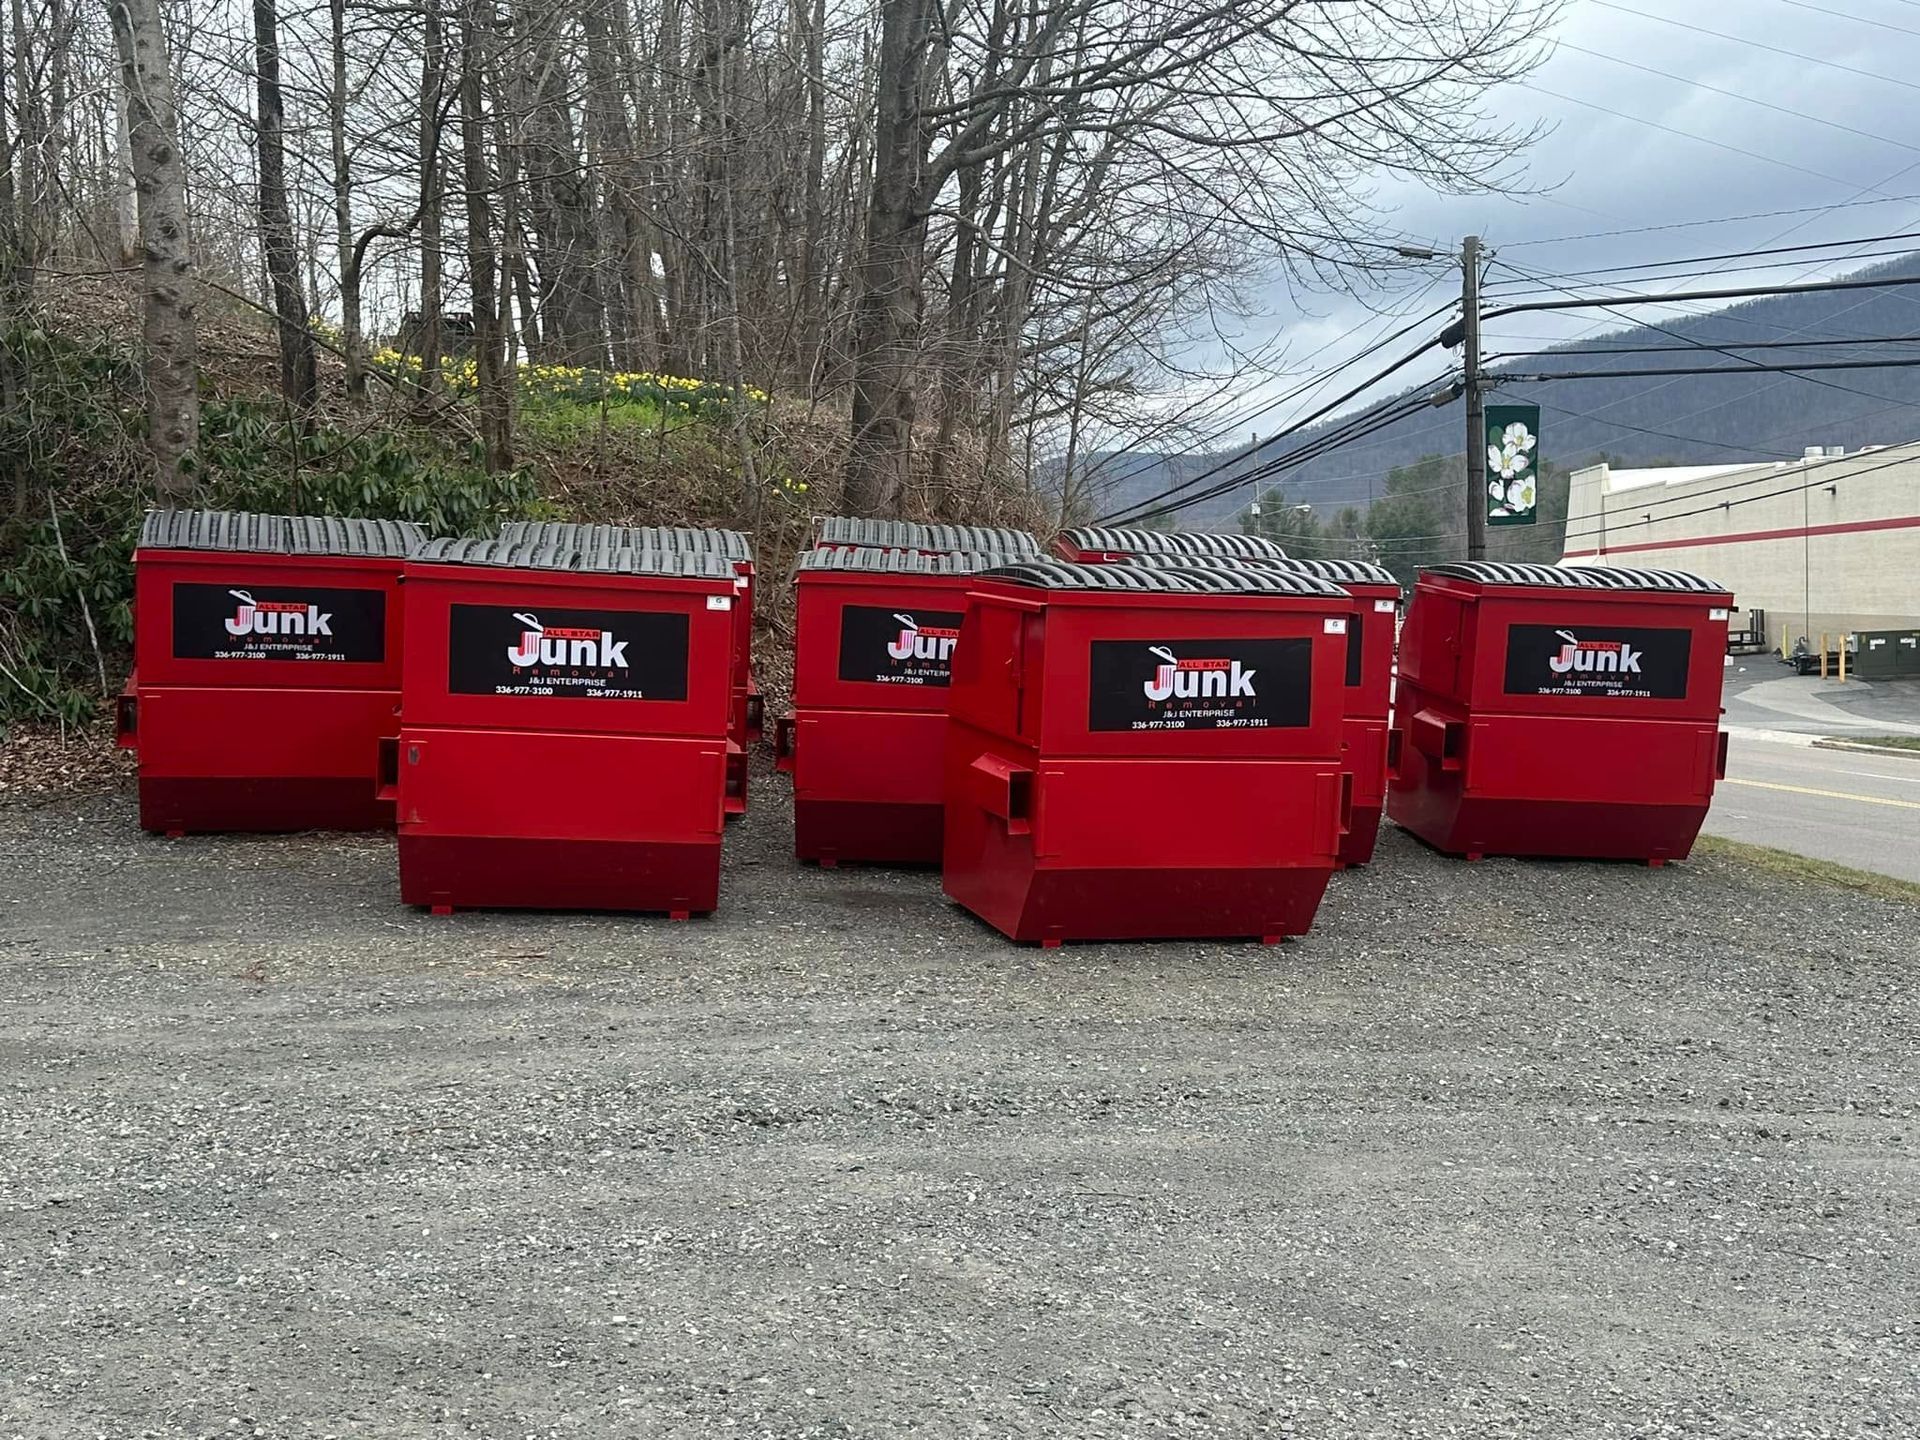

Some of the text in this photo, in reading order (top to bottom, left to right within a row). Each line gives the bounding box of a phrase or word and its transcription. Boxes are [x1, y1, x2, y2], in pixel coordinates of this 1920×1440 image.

[225, 604, 333, 636] Junk
[545, 629, 599, 638] ALL STAR
[940, 629, 959, 637] STA
[260, 643, 313, 651] ENTERPRISE
[507, 631, 629, 667] Junk
[887, 629, 958, 660] Jun
[214, 651, 345, 661] 336-977-3100 336-977-1911
[1549, 643, 1643, 673] Junk
[512, 666, 629, 679] Removal
[918, 668, 951, 677] ENTERP
[528, 676, 607, 687] J&J ENTERPRISE
[876, 674, 924, 684] 336-977-3100
[1144, 660, 1257, 701] Junk
[1577, 680, 1623, 688] ENTERPRISE
[495, 685, 643, 698] 336-977-3100 336-977-1911
[1538, 687, 1651, 697] 336-977-3100 336-977-1911
[1148, 699, 1257, 710] Removal
[1162, 709, 1235, 718] J&J ENTERPRISE
[1131, 718, 1268, 729] 336-977-3100 336-977-1911
